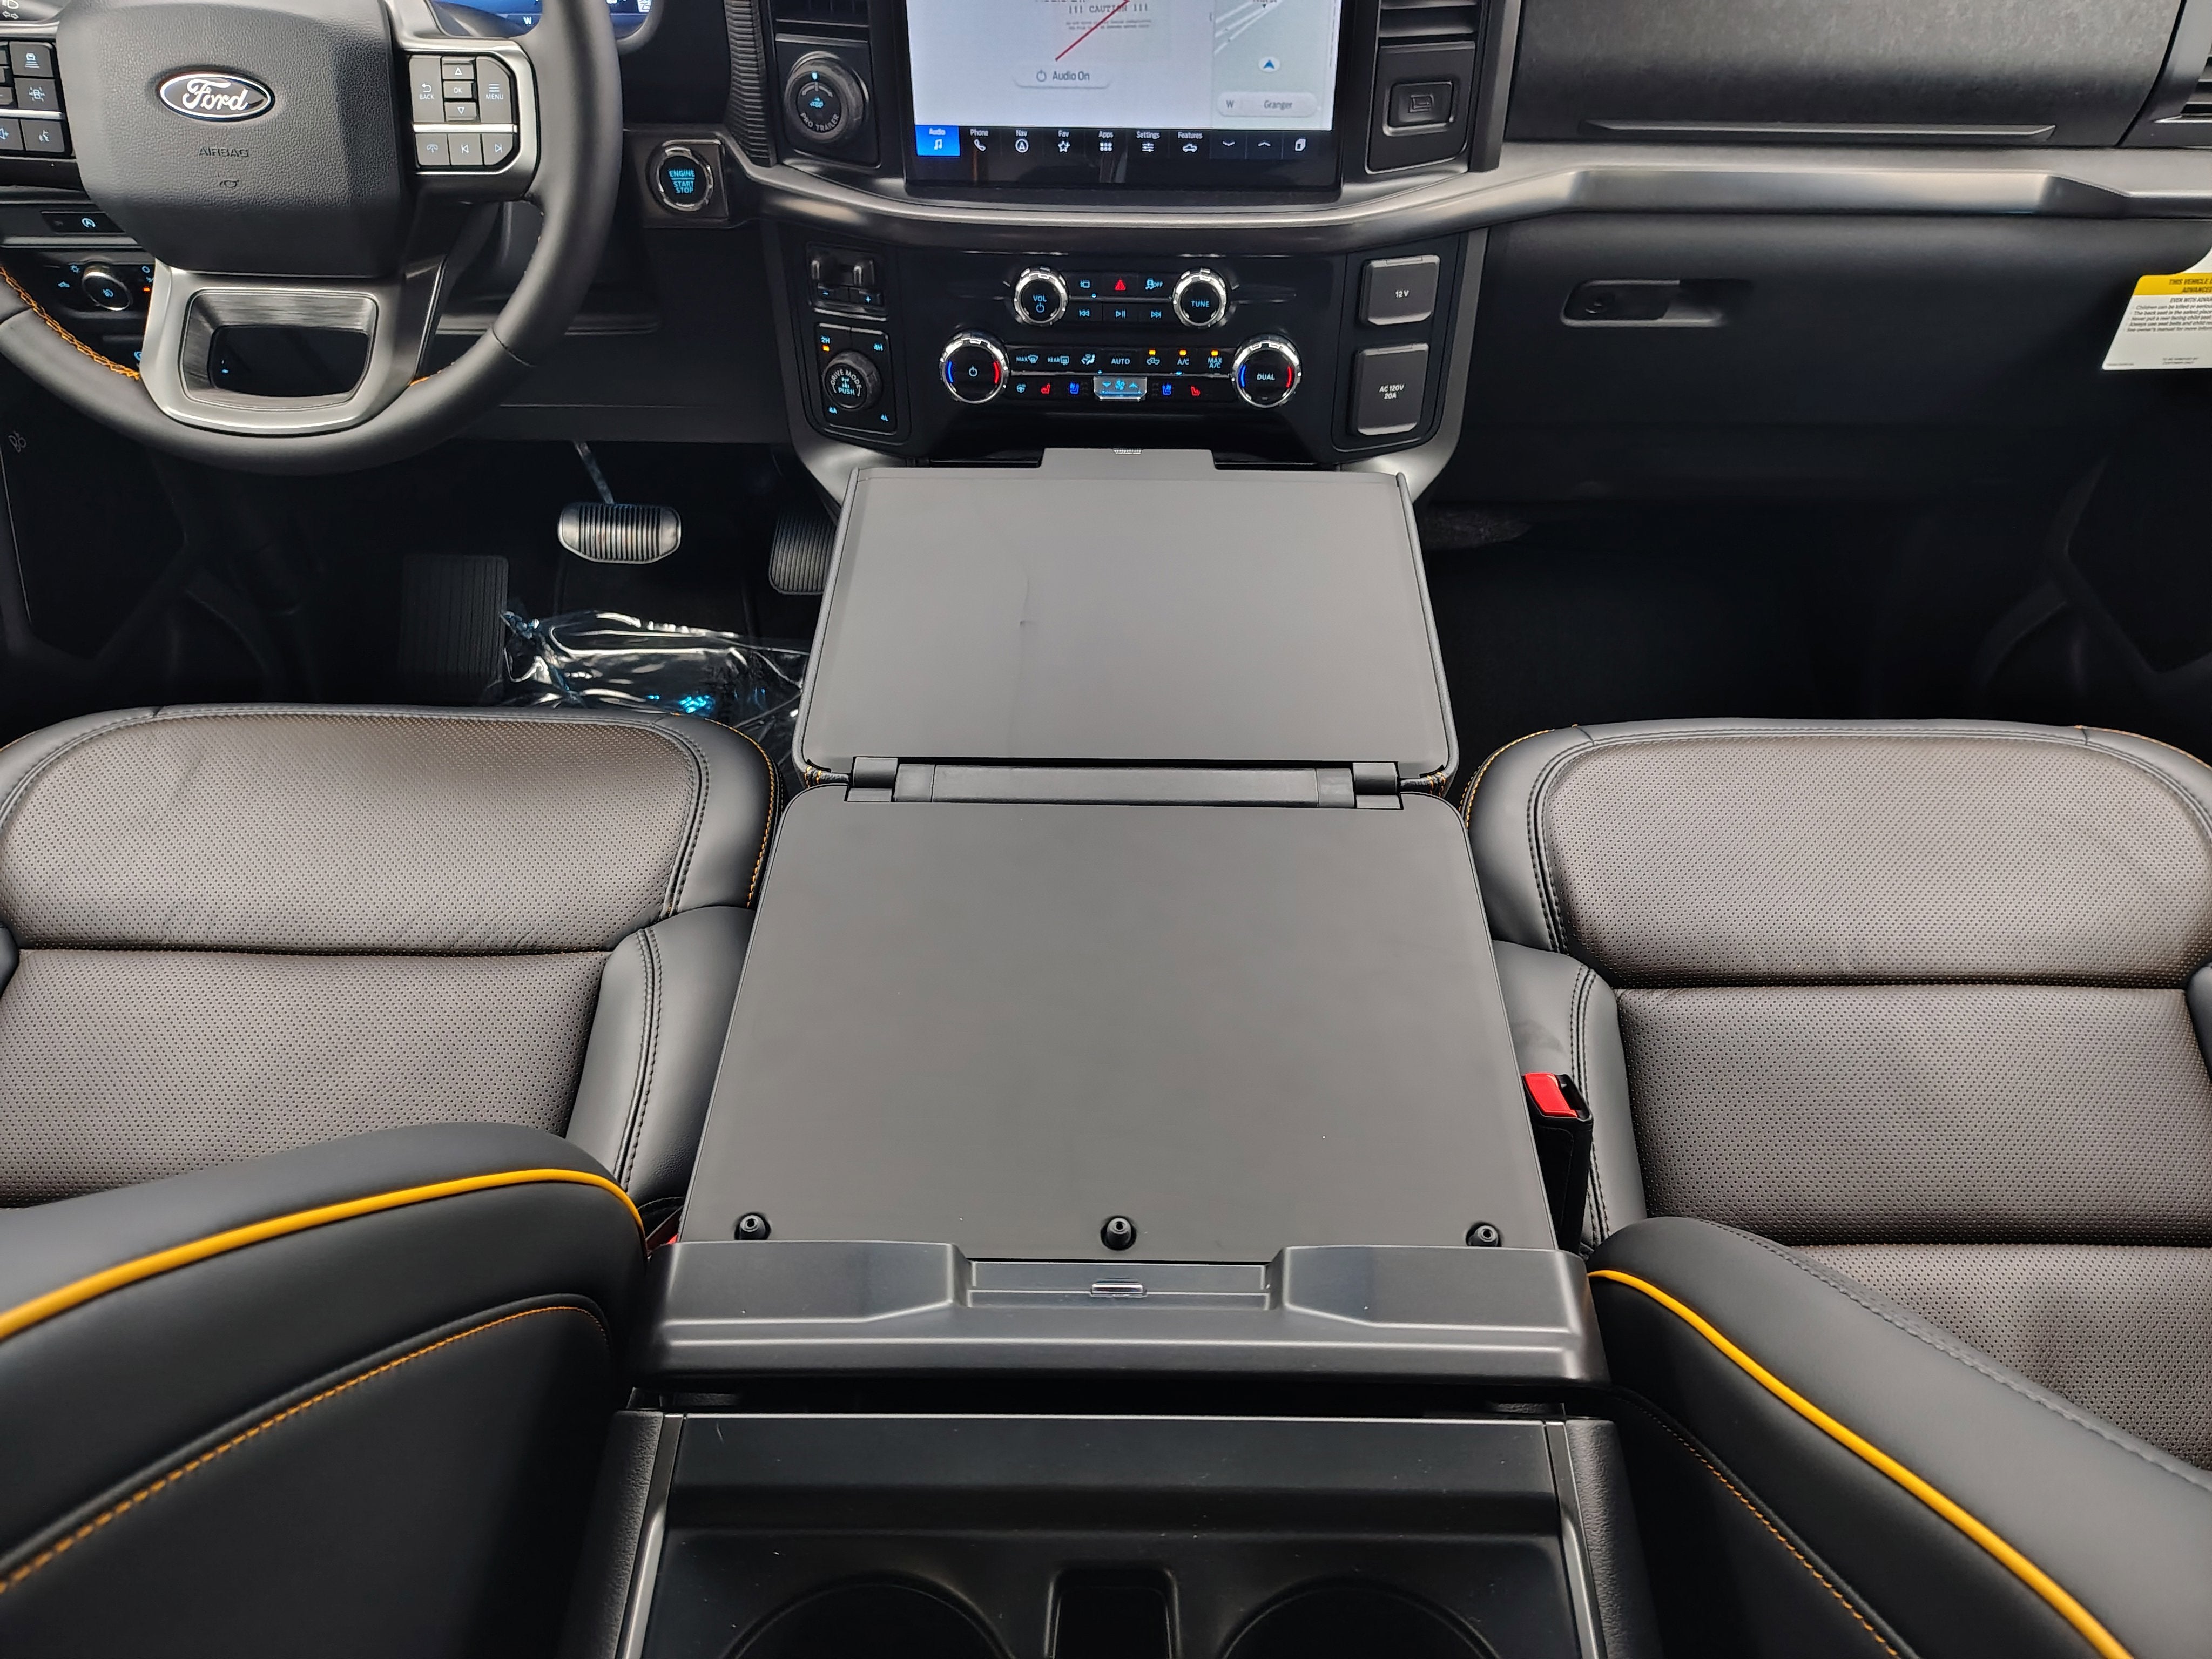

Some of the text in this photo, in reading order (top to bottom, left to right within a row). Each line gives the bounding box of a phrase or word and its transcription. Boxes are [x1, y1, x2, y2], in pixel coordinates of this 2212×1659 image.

[523, 17, 532, 25] W
[1053, 71, 1090, 80] Audio On
[182, 79, 248, 111] Ford
[1264, 100, 1293, 110] Granger
[800, 112, 840, 132] PRO TRAILER
[1098, 131, 1114, 139] Apps
[1136, 131, 1161, 139] Settings
[1177, 131, 1203, 139] Features
[199, 147, 249, 158] AIRBAG
[820, 335, 831, 344] 2H
[873, 343, 884, 352] 4H
[830, 369, 862, 389] DRIVE MODE
[838, 387, 855, 396] PUSH
[1389, 384, 1404, 392] 120V
[828, 407, 838, 415] 4A
[880, 414, 889, 422] 4L
